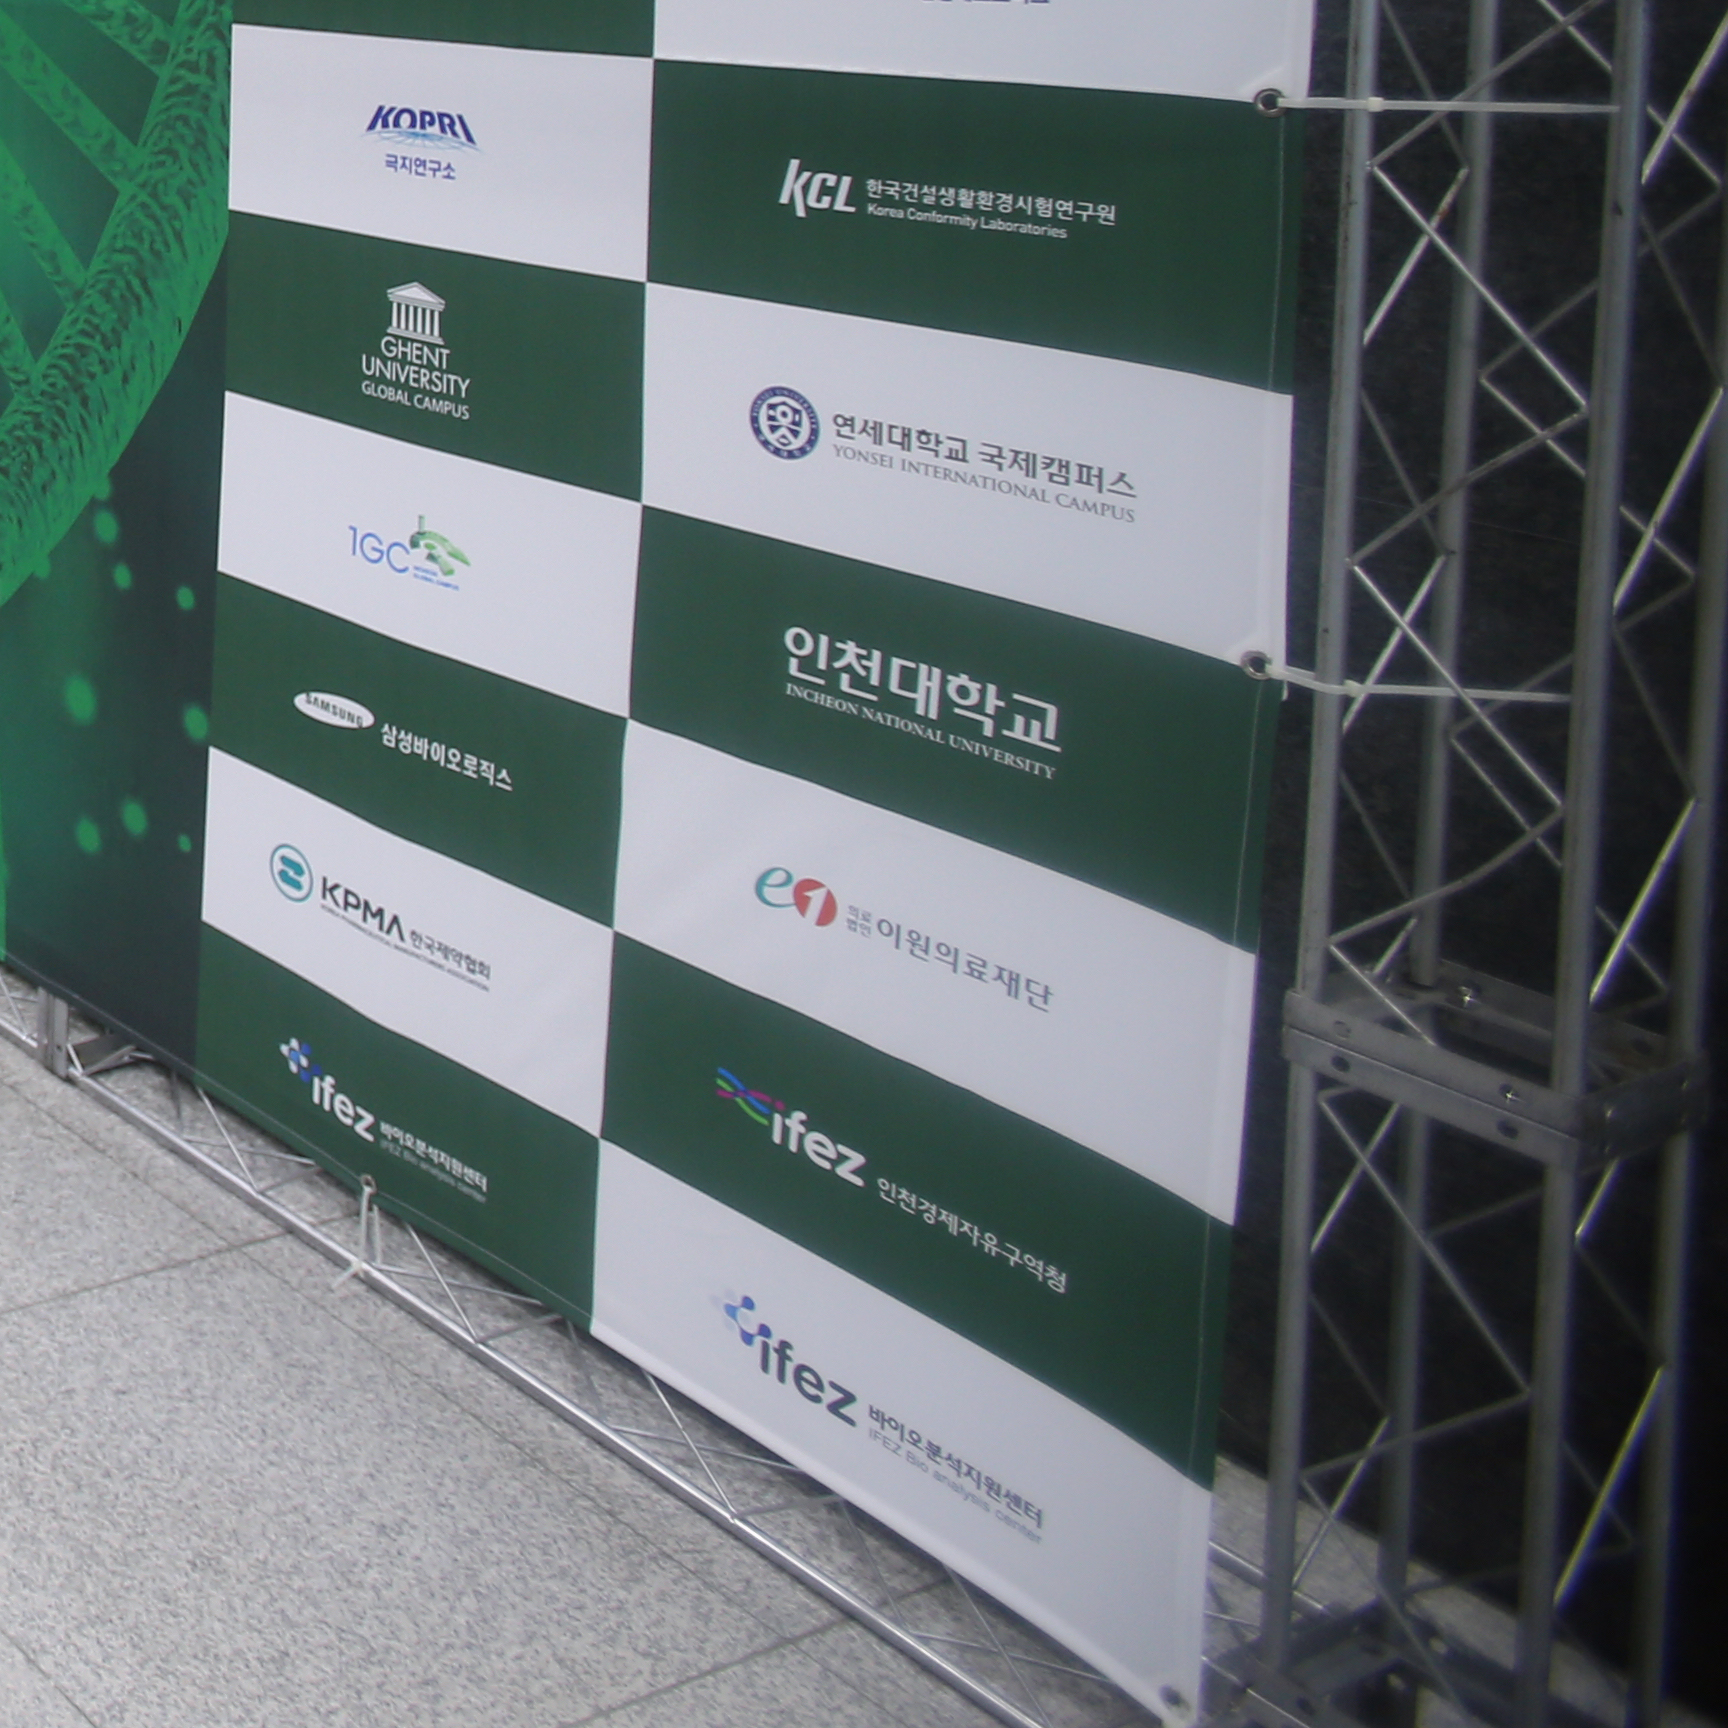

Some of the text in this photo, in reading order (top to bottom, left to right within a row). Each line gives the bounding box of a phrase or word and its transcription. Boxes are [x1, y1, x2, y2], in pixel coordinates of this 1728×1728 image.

[366, 105, 476, 145] KOPRI
[385, 153, 456, 180] 극지연구소
[779, 158, 856, 218] KCL
[866, 178, 1116, 226] 한국건설생활환경시험연구원
[867, 203, 1067, 239] Korea Conformity Laboratories
[362, 354, 470, 398] UNIVERSITY
[381, 336, 450, 369] GHENT
[362, 380, 470, 420] GLOBAL CAMPUS
[832, 413, 970, 464] 연세대학교
[978, 442, 1137, 498] 국제캠퍼스
[832, 444, 1135, 523] YONSEI INTERNATIONAL CAMPUS
[305, 692, 365, 728] SAMSUNG
[784, 626, 1062, 753] 인천대학교
[381, 723, 512, 791] 삼성바이오로직스
[785, 682, 1056, 780] INCHEON NATIONAL UNIVERSITY
[321, 876, 406, 942] KPMA
[410, 929, 491, 980] 한국제약협회
[876, 918, 1054, 1013] 이원의료재단
[312, 1075, 375, 1142] ifez
[380, 1122, 488, 1192] 바이오분석지원센터
[772, 1102, 866, 1187] ifez
[877, 1178, 1067, 1294] 인천경제자유구역청
[760, 1339, 856, 1427] ifez
[869, 1404, 1043, 1528] 바이오분석지원센터
[869, 1427, 1041, 1544] IFEZ Bio analysis center
